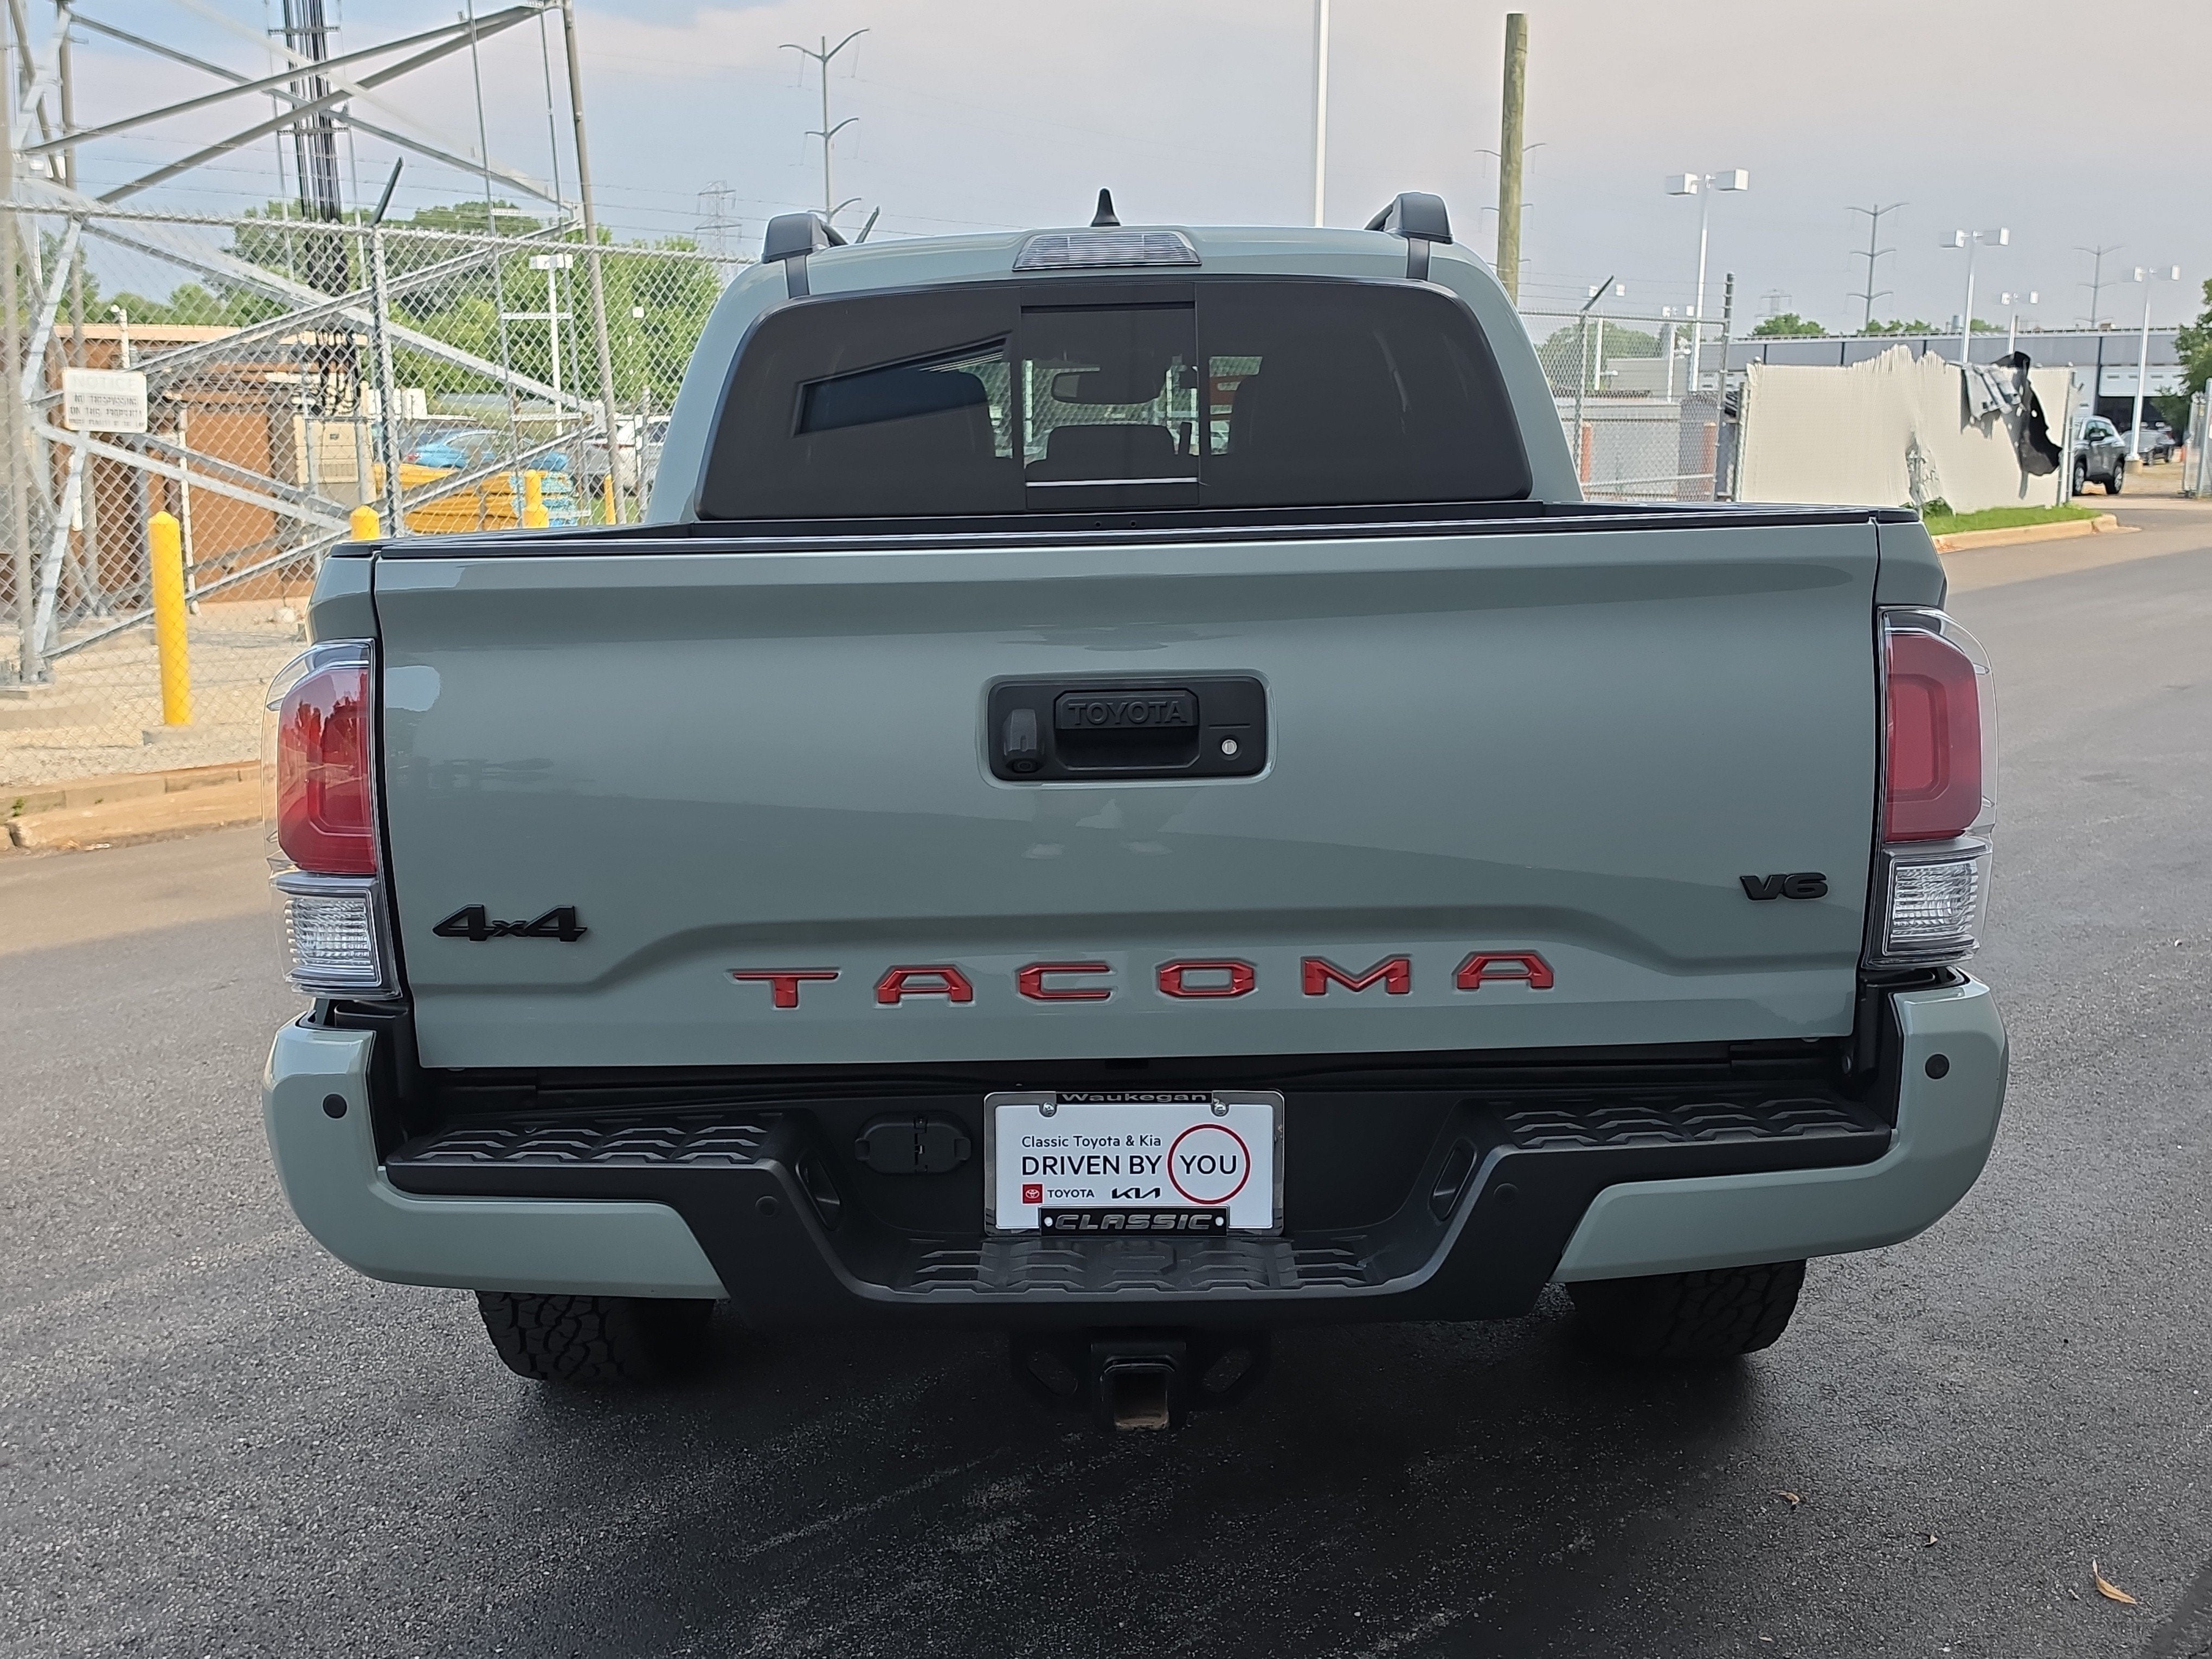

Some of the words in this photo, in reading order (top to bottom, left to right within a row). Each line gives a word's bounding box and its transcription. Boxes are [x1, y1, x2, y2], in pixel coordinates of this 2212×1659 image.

[1068, 700, 1187, 725] TOYOTA
[1739, 872, 1829, 901] V6
[731, 951, 1554, 1008] TACOMA
[1061, 1093, 1207, 1103] Waukegan
[1022, 1135, 1069, 1148] Classic
[1073, 1135, 1121, 1150] Toyota
[1125, 1135, 1135, 1147] &
[1140, 1135, 1161, 1147] Kia
[1022, 1155, 1120, 1175] DRIVEN
[1129, 1155, 1162, 1175] BY
[1179, 1155, 1237, 1175] YOU
[1047, 1189, 1095, 1199] TOYOTA
[1054, 1214, 1213, 1231] CLASSIC
